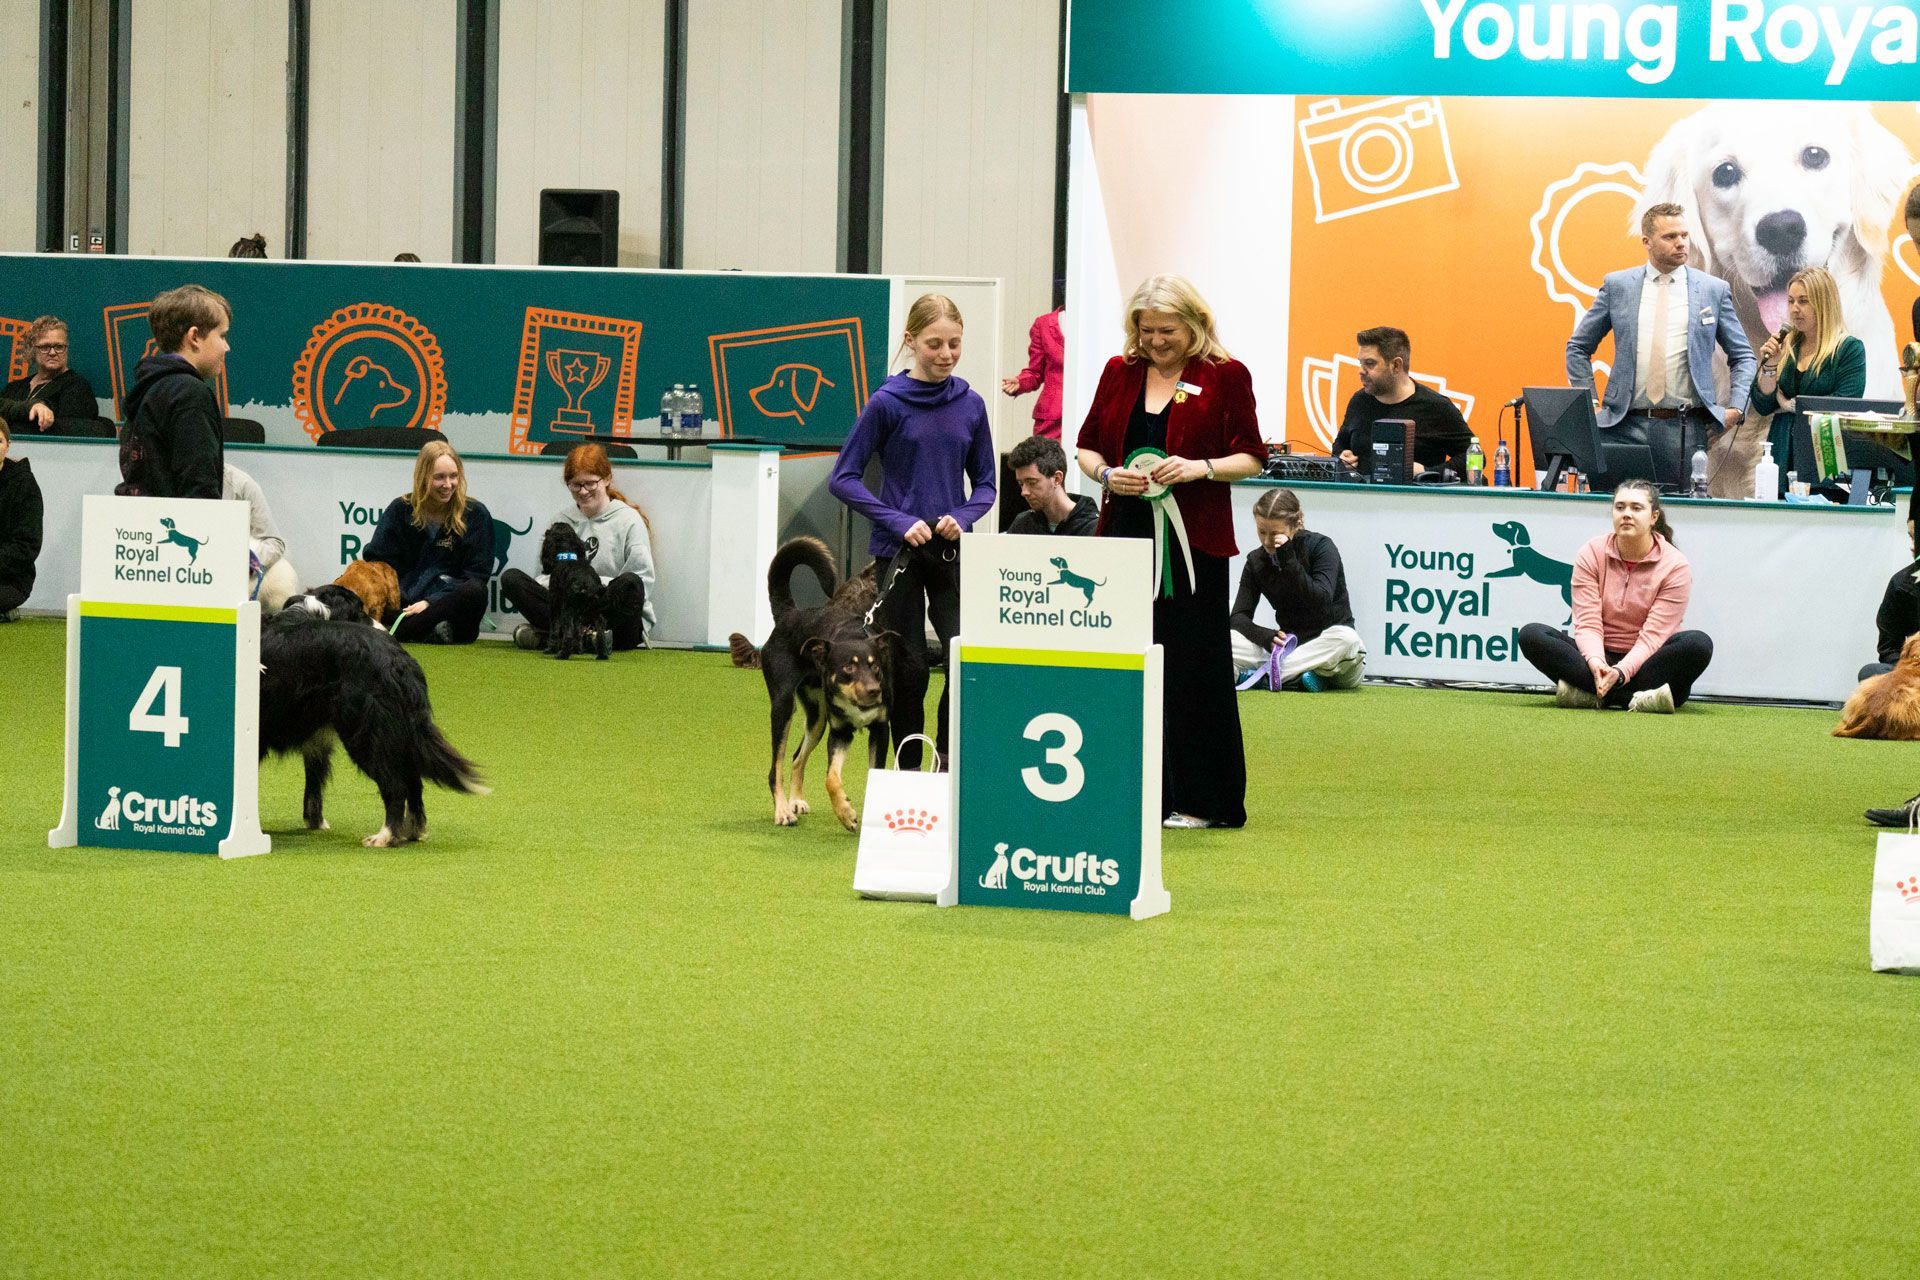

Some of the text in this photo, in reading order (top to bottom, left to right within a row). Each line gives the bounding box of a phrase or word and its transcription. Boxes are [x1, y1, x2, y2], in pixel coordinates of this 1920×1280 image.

[1421, 0, 1919, 86] Young Roya
[339, 501, 383, 526] You
[115, 528, 153, 545] Young
[115, 544, 159, 566] Royal
[1385, 543, 1474, 579] Young
[115, 566, 213, 585] Kennel Club
[998, 568, 1042, 586] Young
[999, 585, 1050, 608] Royal
[1385, 580, 1490, 625] Royal
[999, 607, 1112, 629] Kennel Club
[1384, 622, 1519, 663] Kennel
[129, 665, 189, 748] 4
[1020, 712, 1086, 803] 3
[122, 791, 217, 827] Crufts
[133, 823, 206, 836] Royal Kennel Club
[1011, 847, 1119, 886] Crufts
[1023, 882, 1106, 896] Royal Kennel Club
